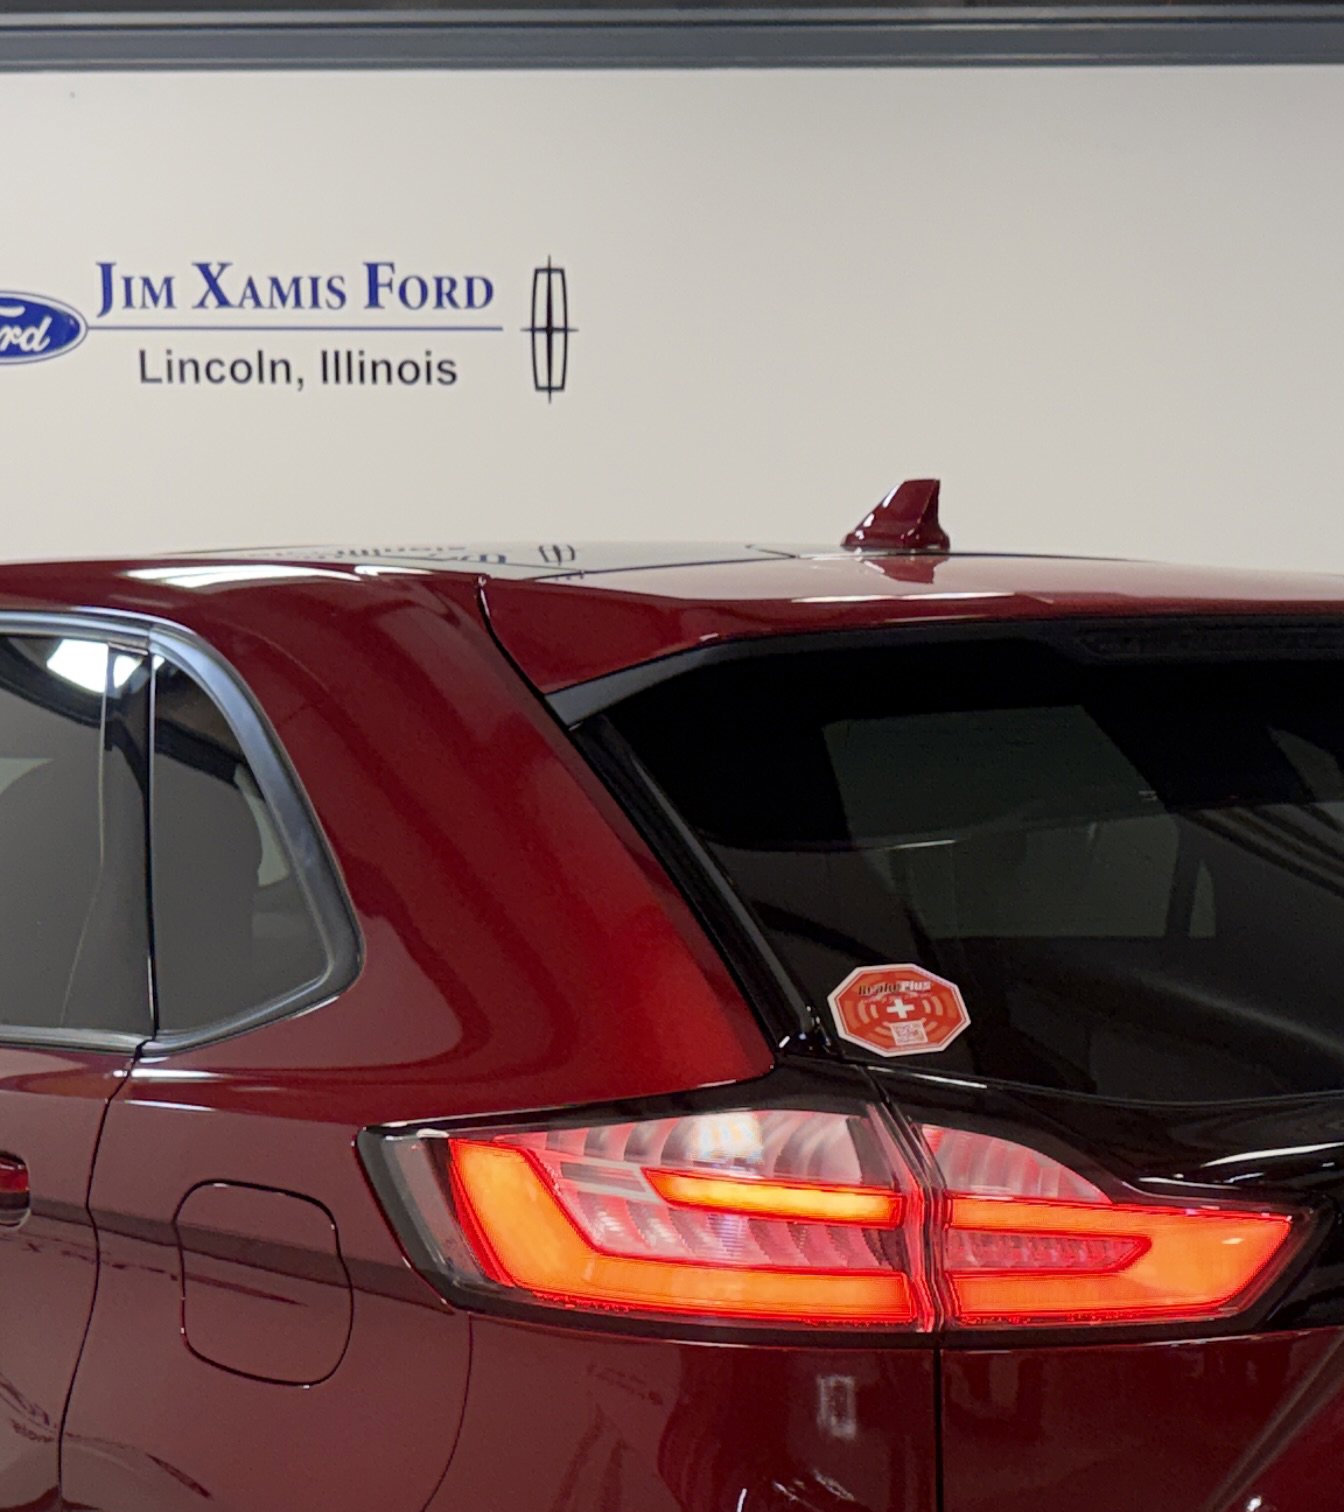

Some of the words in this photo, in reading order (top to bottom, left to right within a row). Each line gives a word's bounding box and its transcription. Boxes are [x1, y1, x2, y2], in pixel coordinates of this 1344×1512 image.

[96, 261, 175, 318] JIM
[191, 261, 348, 311] XAMIS
[362, 261, 495, 311] FORD
[137, 349, 306, 391] Lincoln,
[321, 349, 458, 386] Illinois
